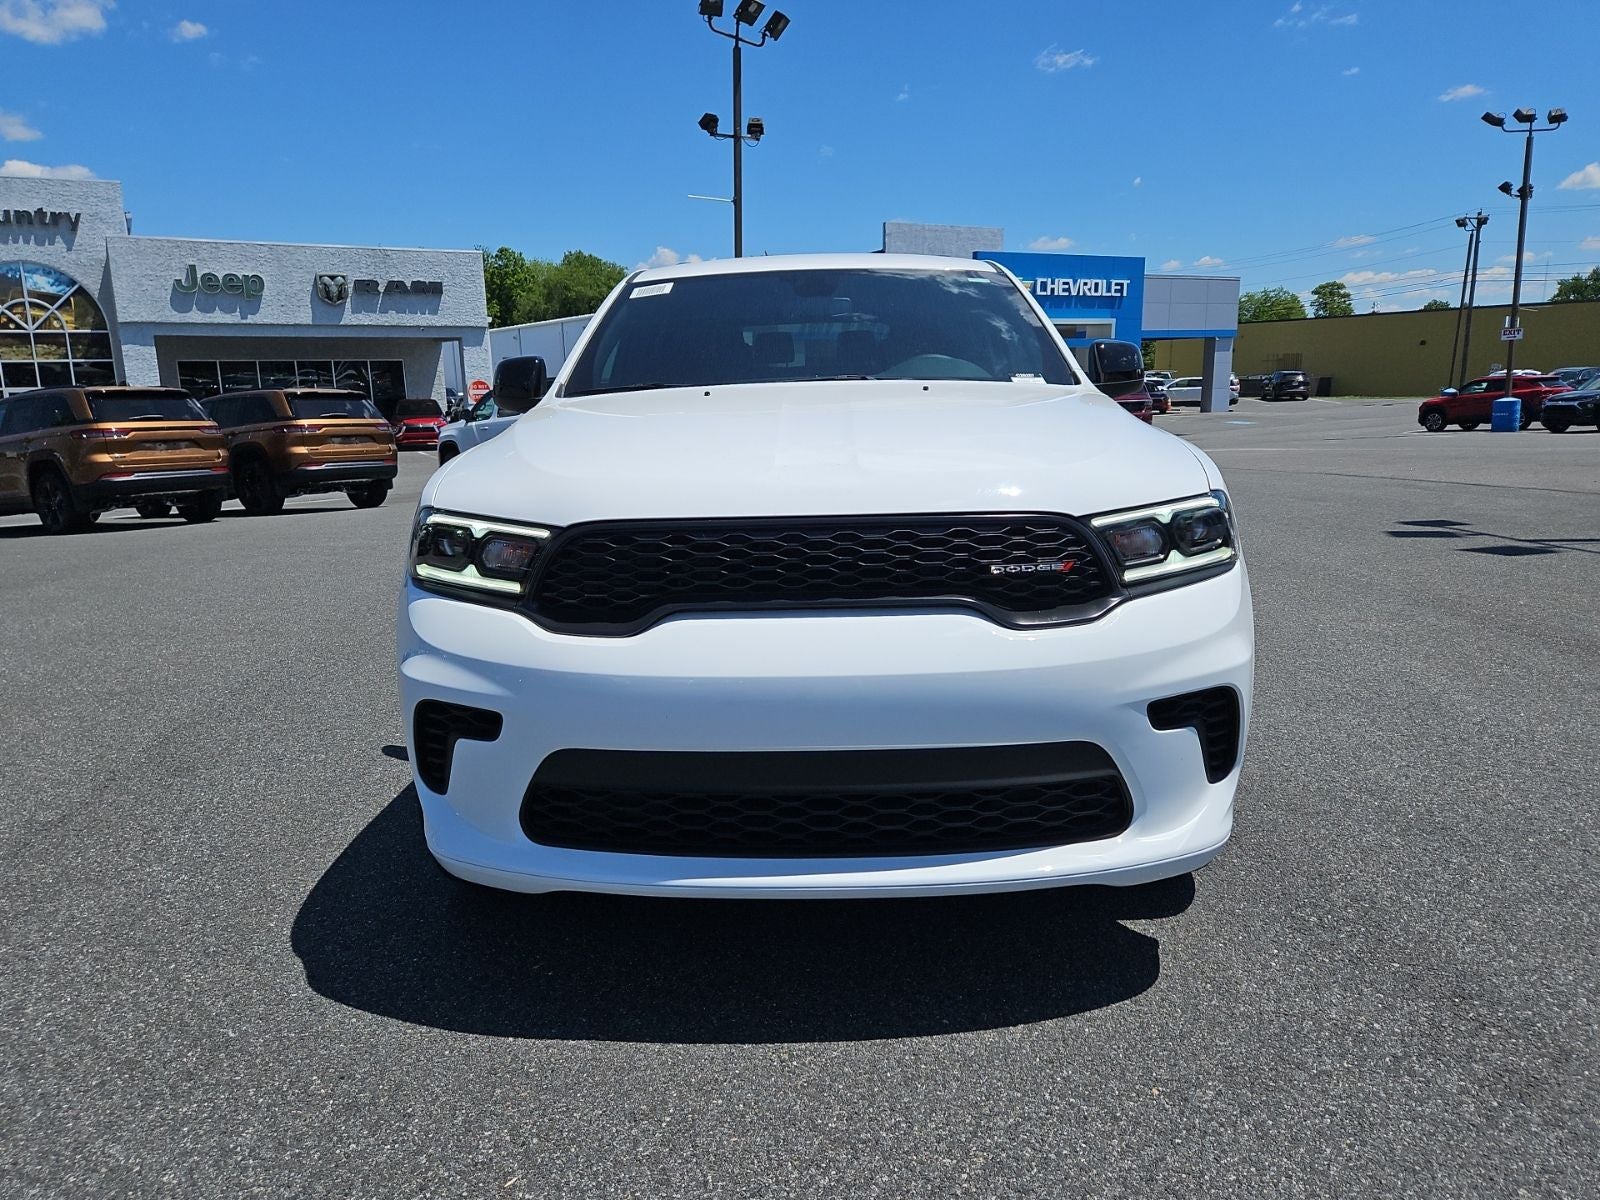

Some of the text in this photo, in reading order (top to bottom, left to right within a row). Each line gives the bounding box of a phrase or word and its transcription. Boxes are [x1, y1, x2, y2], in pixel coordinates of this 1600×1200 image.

[173, 264, 265, 301] Jeep
[353, 279, 443, 296] RAM
[1035, 277, 1131, 297] CHEVROLET
[1503, 328, 1522, 336] EXIT
[990, 562, 1065, 574] DODGE
